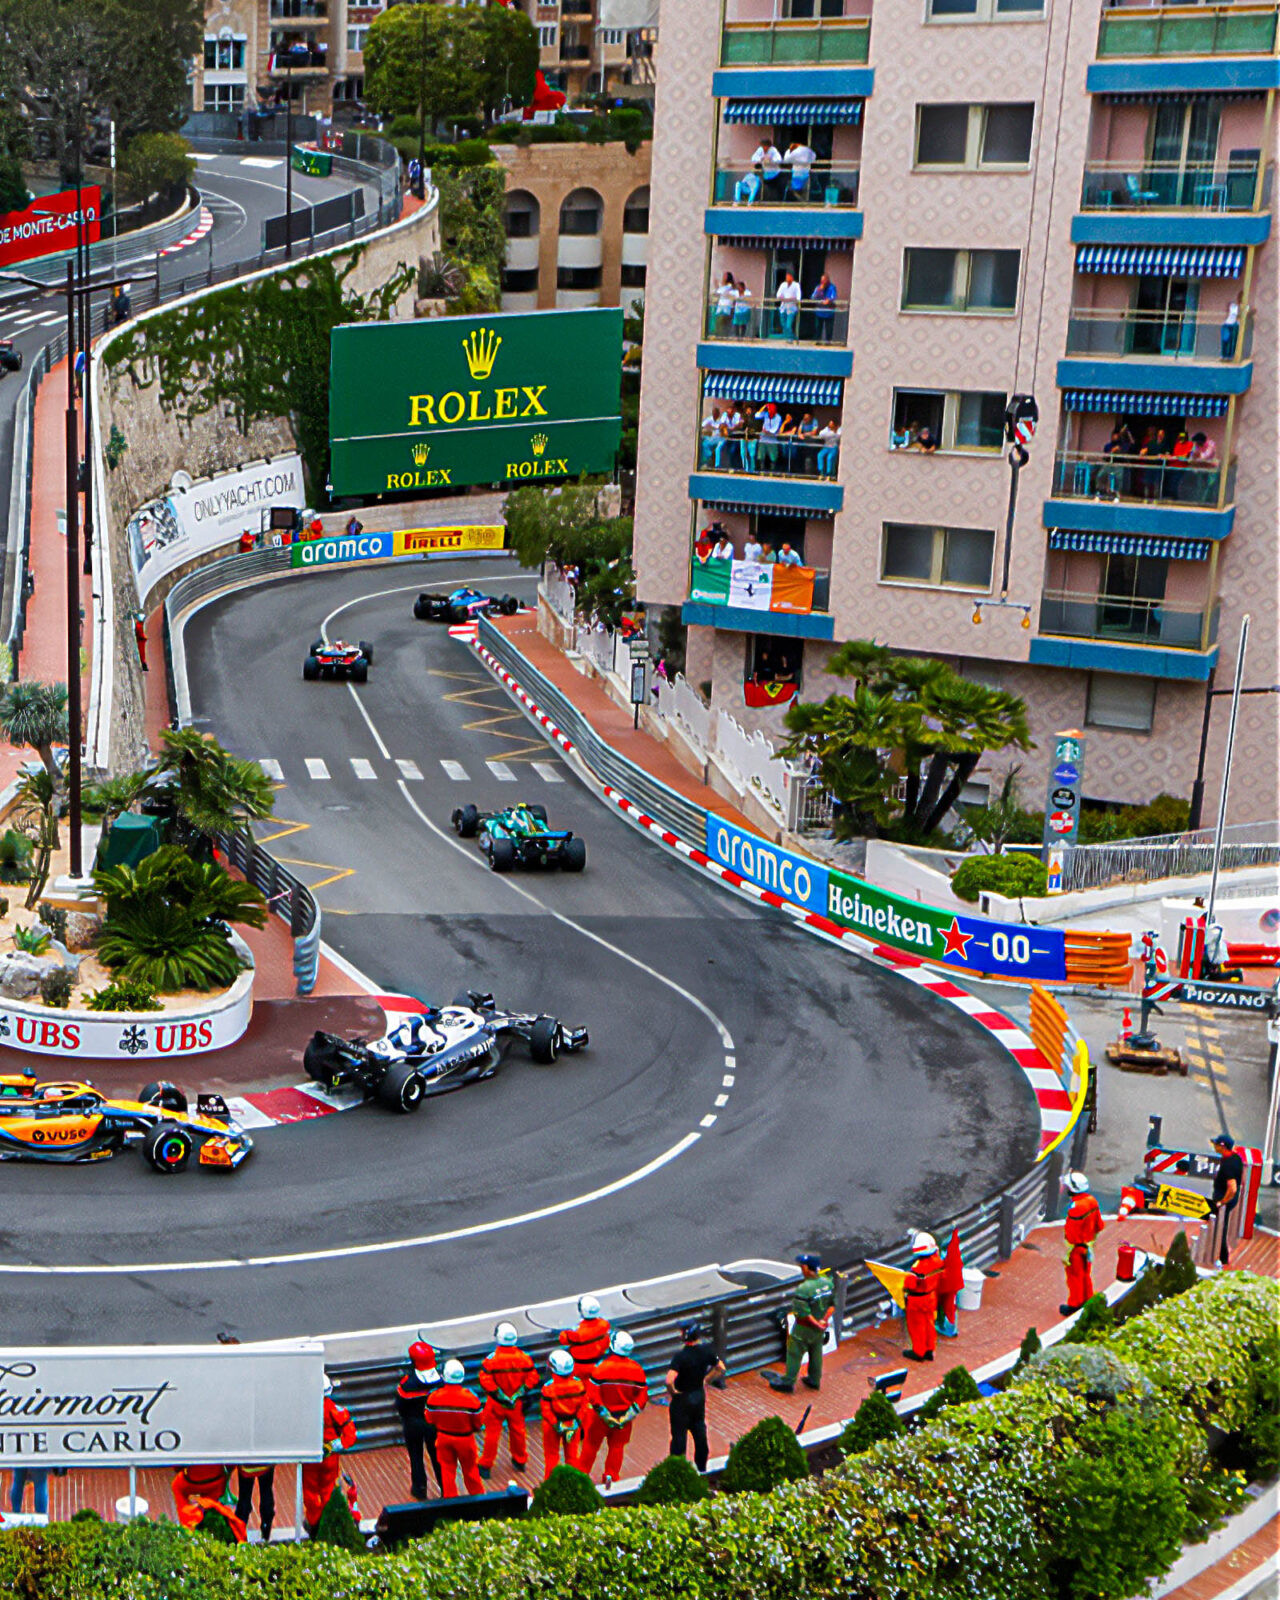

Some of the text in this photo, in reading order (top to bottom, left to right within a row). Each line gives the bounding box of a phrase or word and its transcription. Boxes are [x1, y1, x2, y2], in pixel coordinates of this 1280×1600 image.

[407, 385, 548, 426] ROLEX
[386, 469, 452, 489] ROLEX
[506, 458, 569, 479] ROLEX
[301, 537, 382, 564] aramco
[404, 530, 463, 550] PIRELLI
[717, 828, 811, 902] aramco
[828, 884, 933, 947] Heineken
[16, 1017, 80, 1050] UBS
[155, 1019, 214, 1054] UBS
[63, 1429, 182, 1452] CARLO
